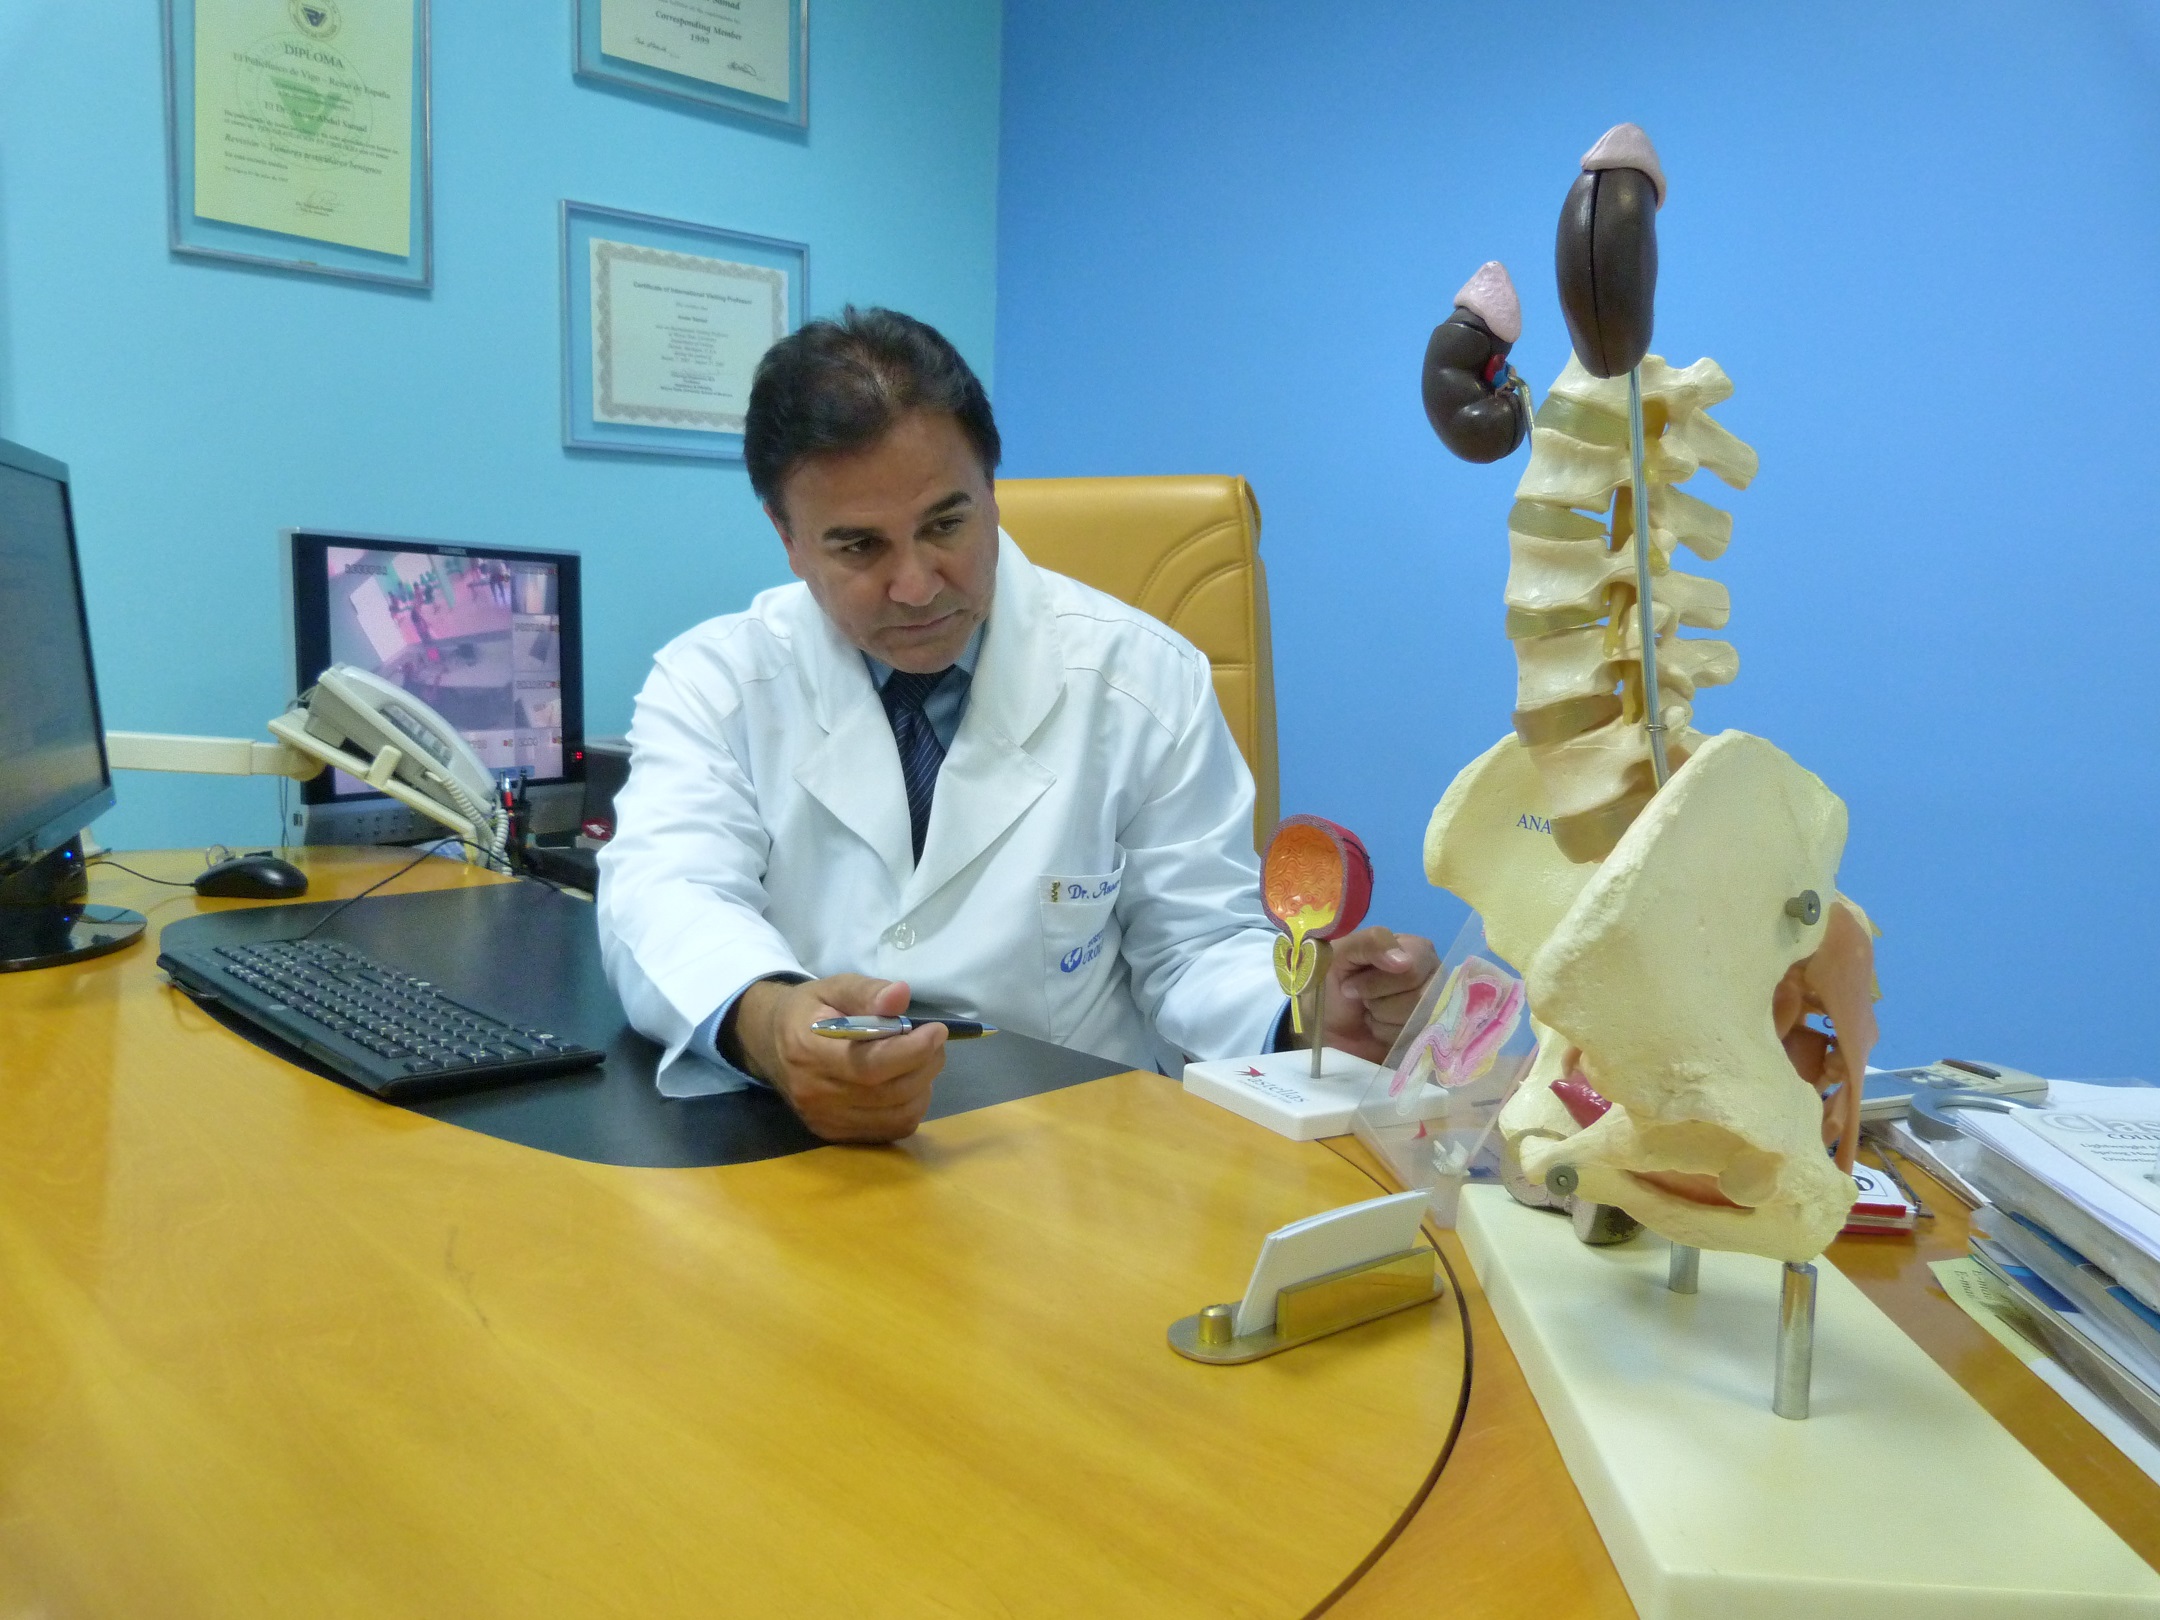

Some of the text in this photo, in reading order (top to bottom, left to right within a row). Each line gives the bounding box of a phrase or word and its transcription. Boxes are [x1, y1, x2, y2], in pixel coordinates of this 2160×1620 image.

[655, 10, 711, 34] Corresponding
[713, 26, 742, 40] Member
[284, 44, 344, 69] DIPLOMA
[1516, 813, 1552, 835] ANA
[1068, 884, 1090, 900] Dr.
